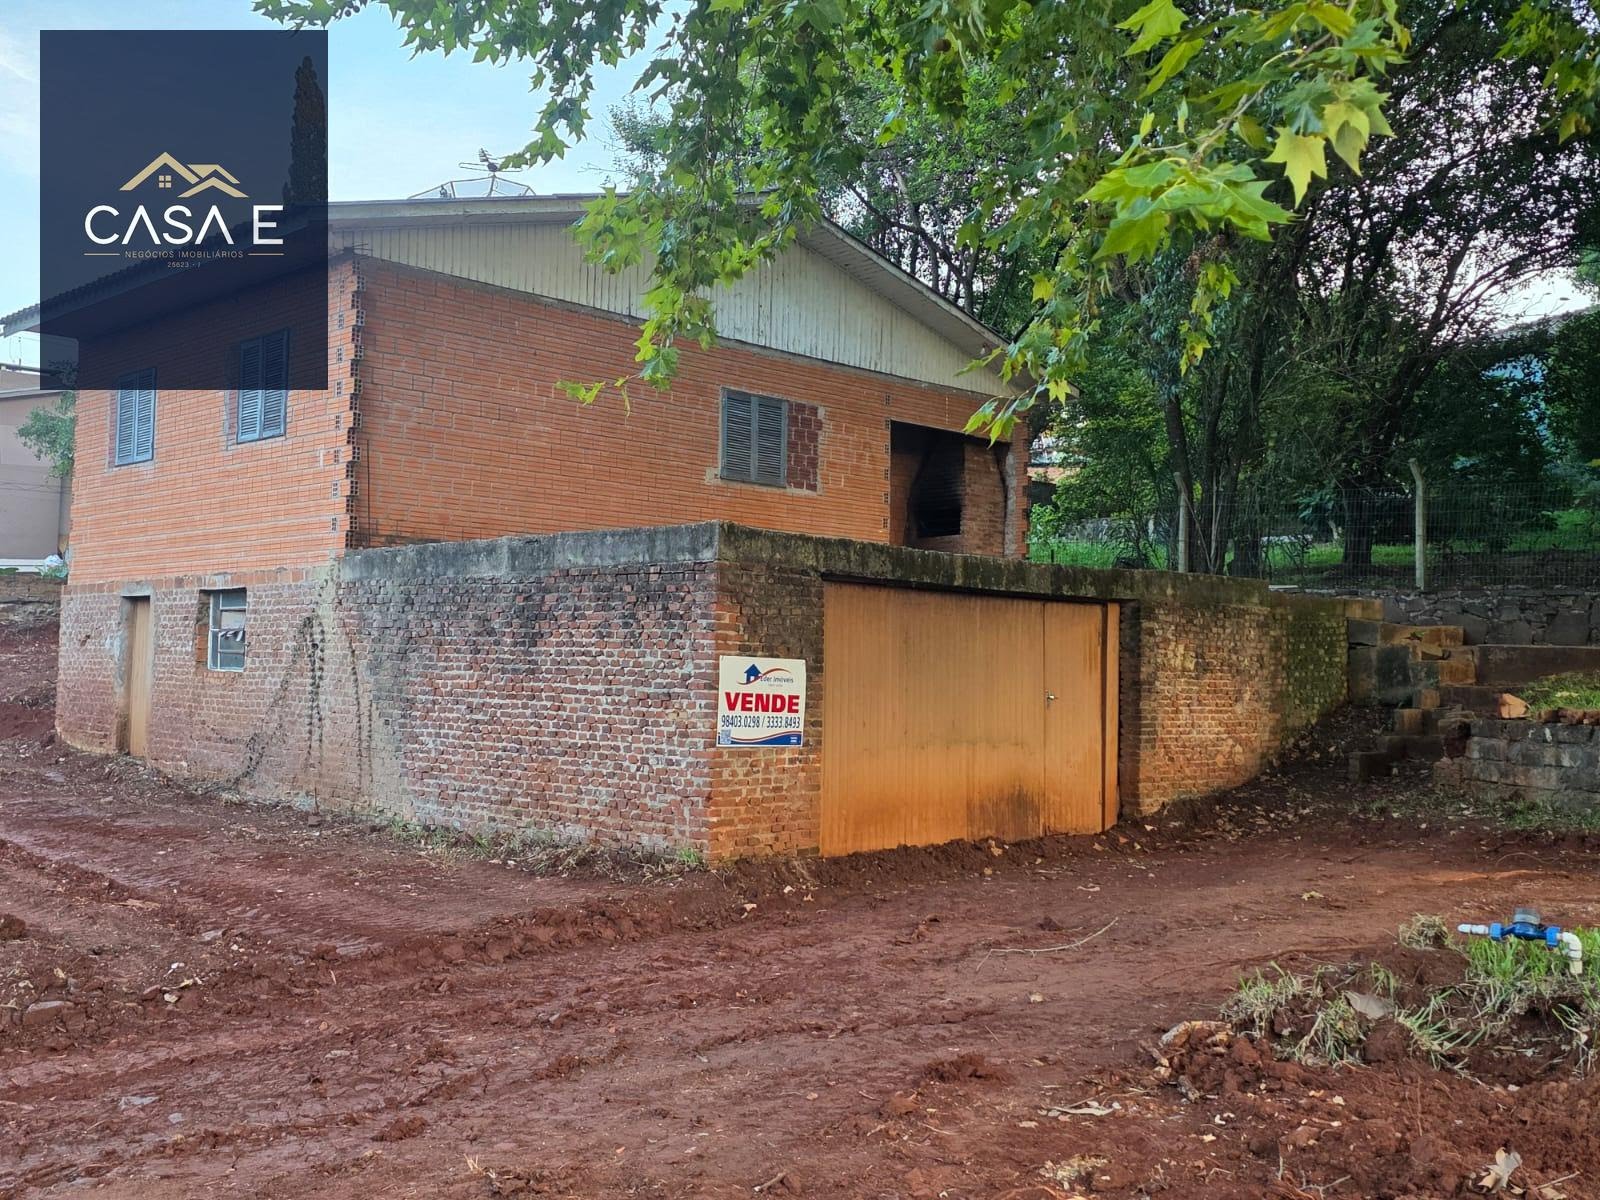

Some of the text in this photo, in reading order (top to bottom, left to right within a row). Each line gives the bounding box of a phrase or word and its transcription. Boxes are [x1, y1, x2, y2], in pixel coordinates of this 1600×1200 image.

[725, 692, 800, 713] VENDE
[721, 715, 760, 728] 98403.0298
[766, 717, 801, 728] 3333.8493
